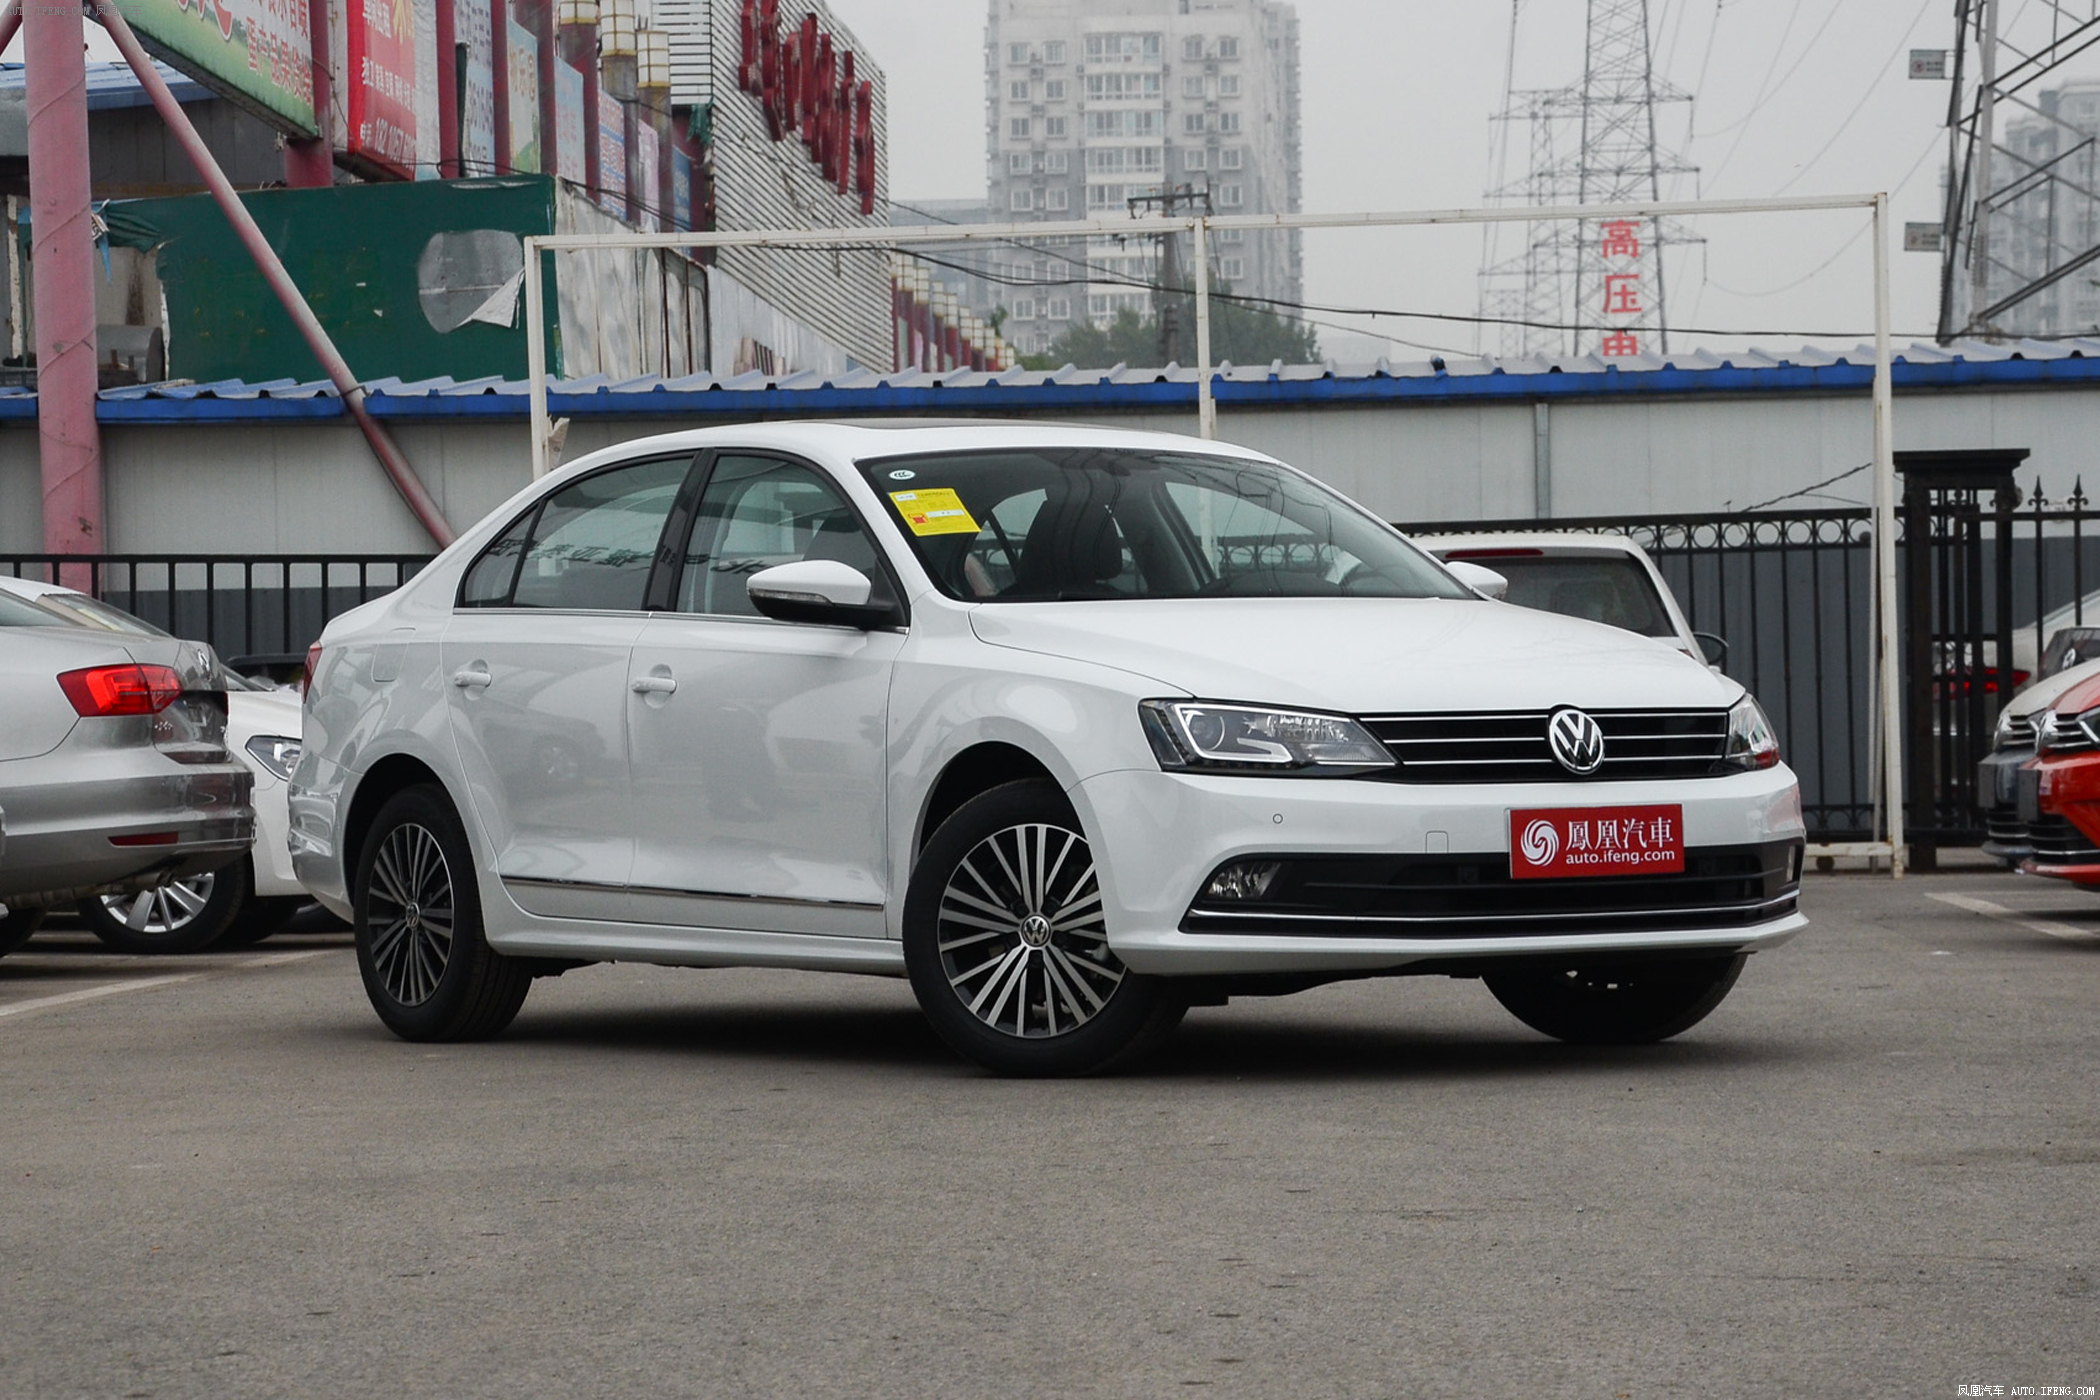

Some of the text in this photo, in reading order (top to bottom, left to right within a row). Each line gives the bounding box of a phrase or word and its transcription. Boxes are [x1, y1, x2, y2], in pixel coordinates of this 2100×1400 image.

[1565, 816, 1674, 851] 鳳凰汽車
[1565, 849, 1675, 865] auto.ifeng.com
